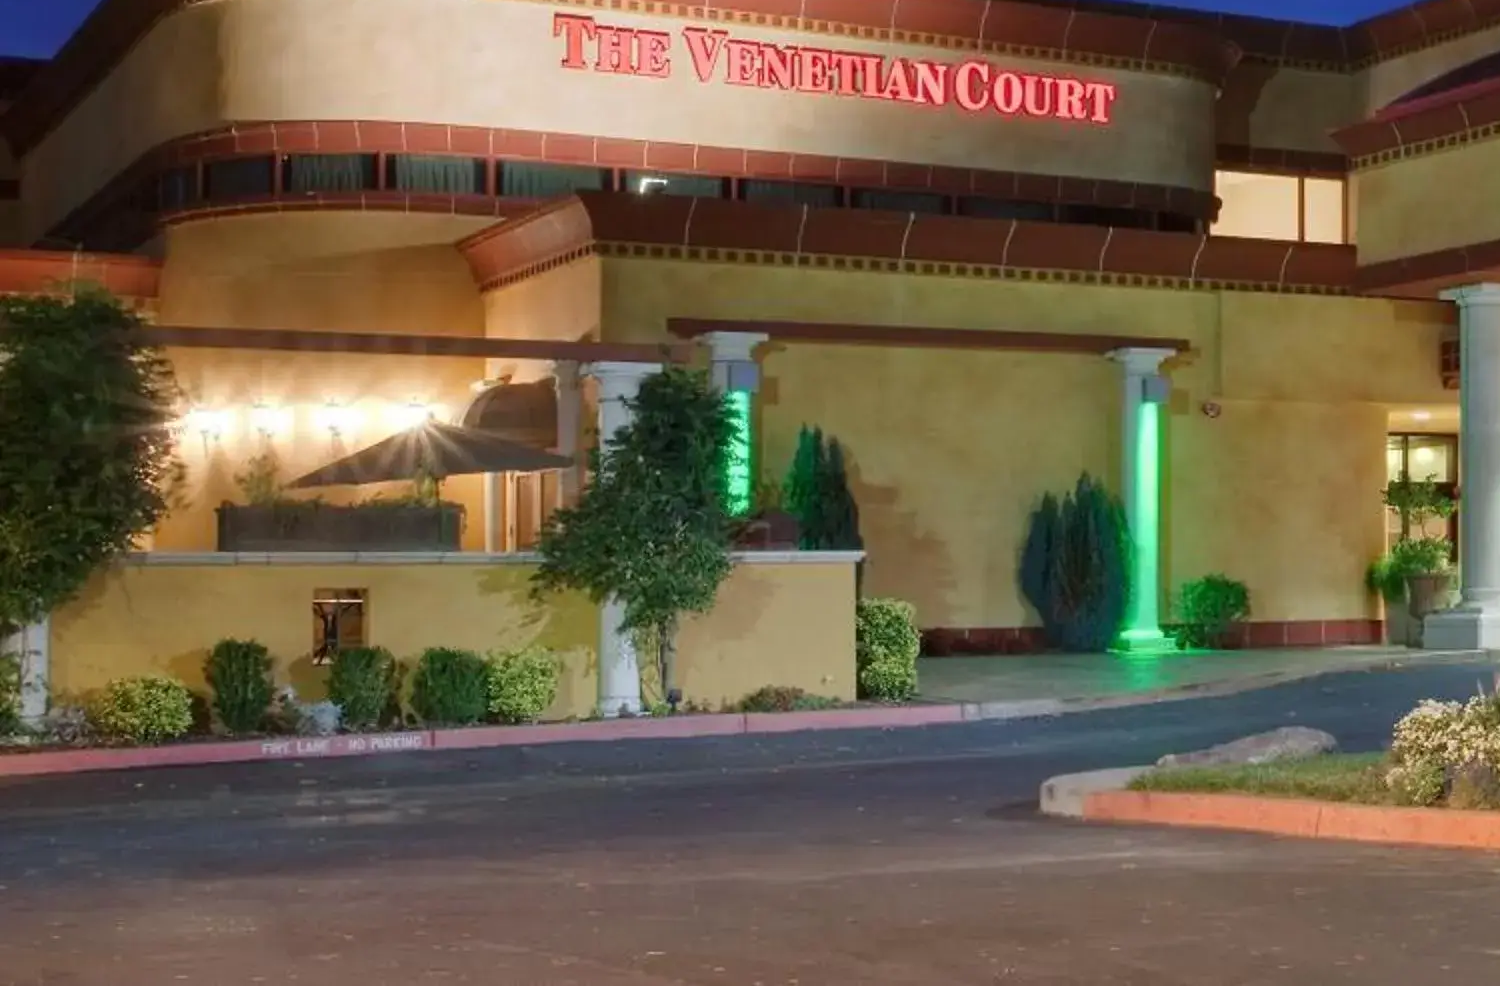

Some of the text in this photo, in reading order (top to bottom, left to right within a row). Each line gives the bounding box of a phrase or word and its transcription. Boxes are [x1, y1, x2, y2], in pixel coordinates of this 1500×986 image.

[554, 13, 1116, 123] THE VENETIAN COURT
[371, 735, 422, 749] PARKING
